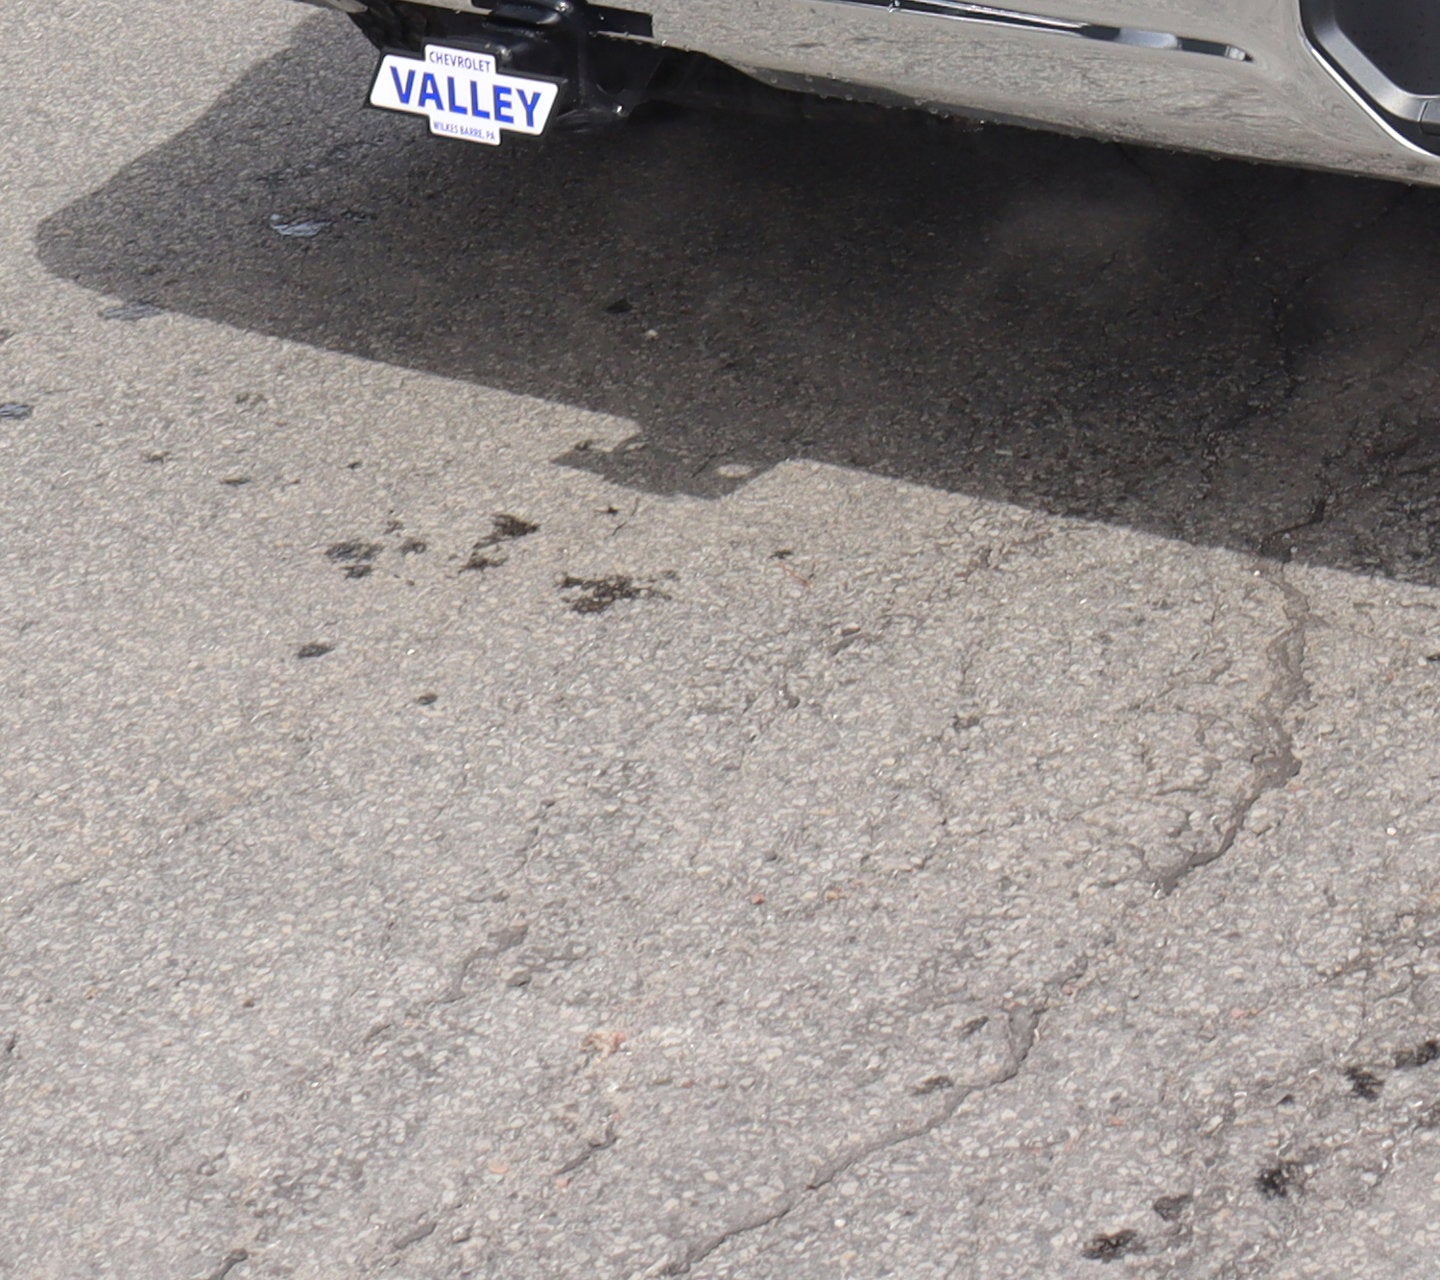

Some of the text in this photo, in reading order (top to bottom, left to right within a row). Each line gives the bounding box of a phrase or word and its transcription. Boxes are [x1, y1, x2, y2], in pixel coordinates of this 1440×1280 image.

[428, 51, 491, 73] CHEVROLET
[389, 65, 542, 128] VALLEY
[432, 121, 459, 135] WILKES
[486, 130, 495, 141] PA
